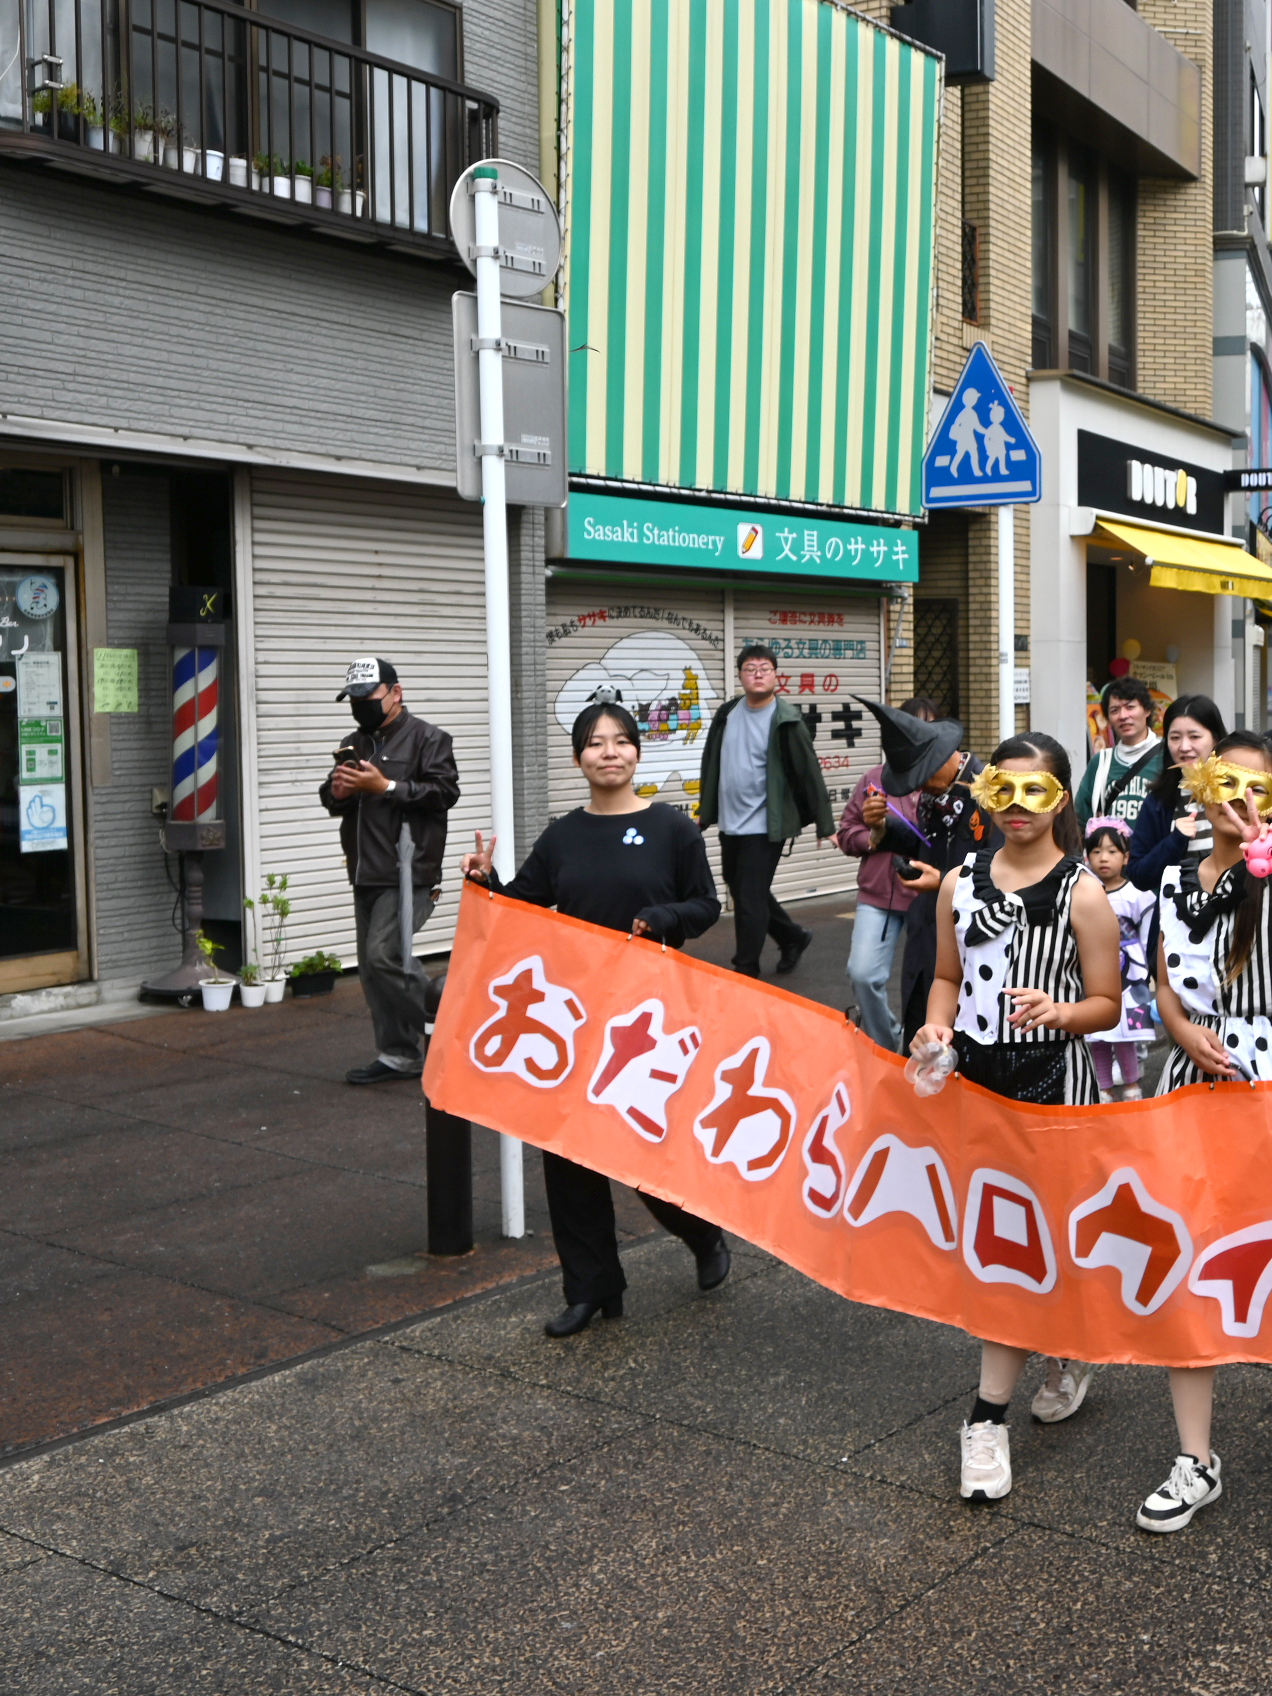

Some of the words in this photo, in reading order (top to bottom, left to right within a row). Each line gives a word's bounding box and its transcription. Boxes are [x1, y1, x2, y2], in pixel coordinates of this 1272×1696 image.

[1128, 459, 1197, 515] DOUTOR
[583, 517, 639, 545] Sasaki
[643, 523, 725, 556] Stationery
[775, 528, 910, 570] 文具のササキ
[768, 610, 845, 627] ご贈答に文具券を
[774, 673, 840, 694] 文具の
